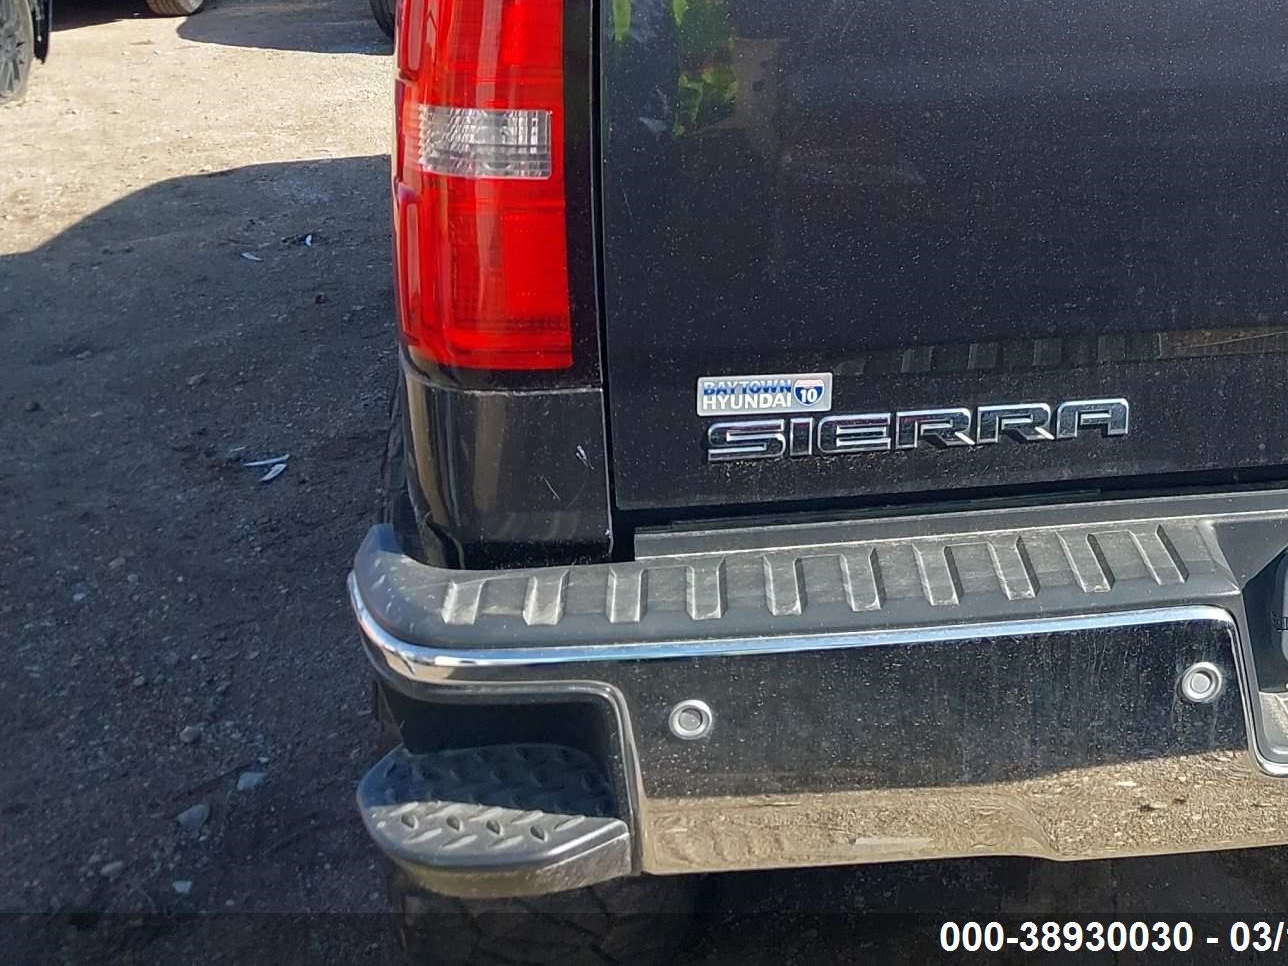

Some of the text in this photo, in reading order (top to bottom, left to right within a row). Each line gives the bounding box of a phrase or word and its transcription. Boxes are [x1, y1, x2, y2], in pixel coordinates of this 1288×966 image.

[703, 379, 792, 395] BAYTOWN
[800, 388, 818, 403] 10
[702, 392, 792, 410] HYUNDAI
[707, 397, 1129, 461] SIERRA
